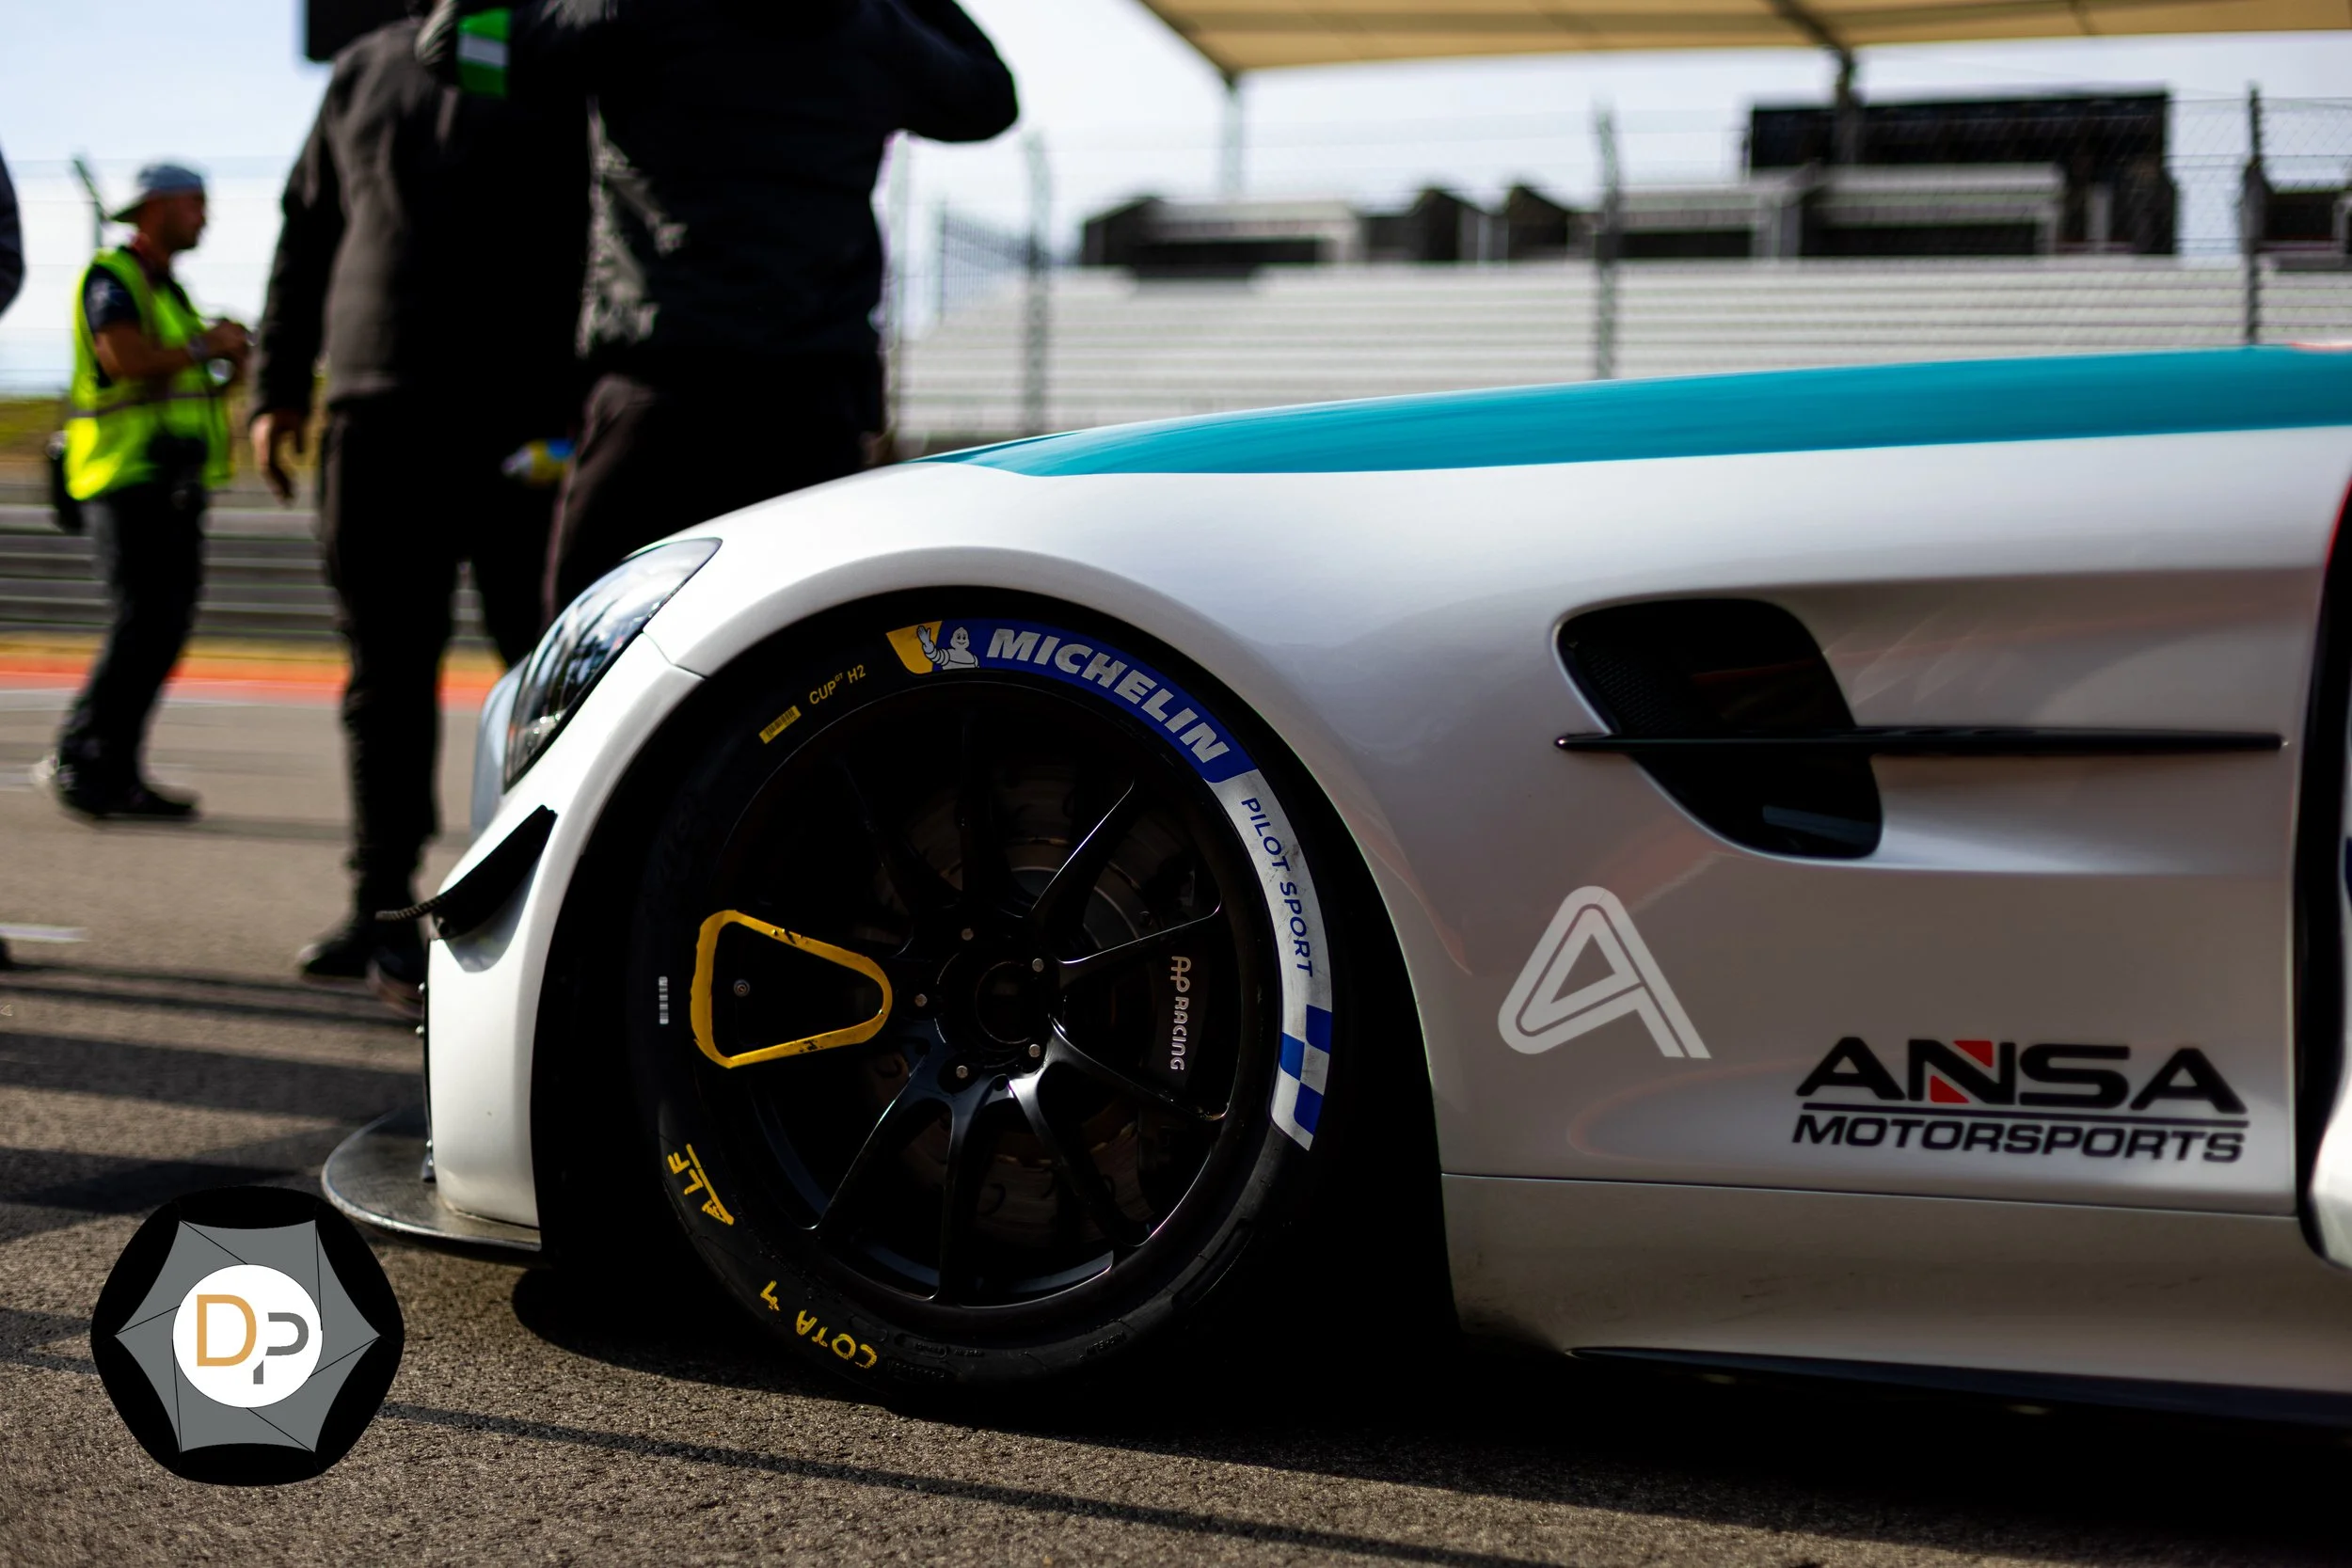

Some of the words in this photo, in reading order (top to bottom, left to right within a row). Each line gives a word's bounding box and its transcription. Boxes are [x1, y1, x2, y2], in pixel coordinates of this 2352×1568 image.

[847, 664, 866, 684] H2
[986, 628, 1230, 763] MICHELIN
[1241, 798, 1291, 871] PILOT
[1279, 881, 1313, 977] SPORT
[1169, 956, 1192, 993] AP
[1169, 997, 1190, 1070] RACING
[1795, 1036, 2247, 1115] ANSA
[1791, 1115, 2244, 1164] MOTORSPORTS
[796, 1309, 878, 1369] COTA
